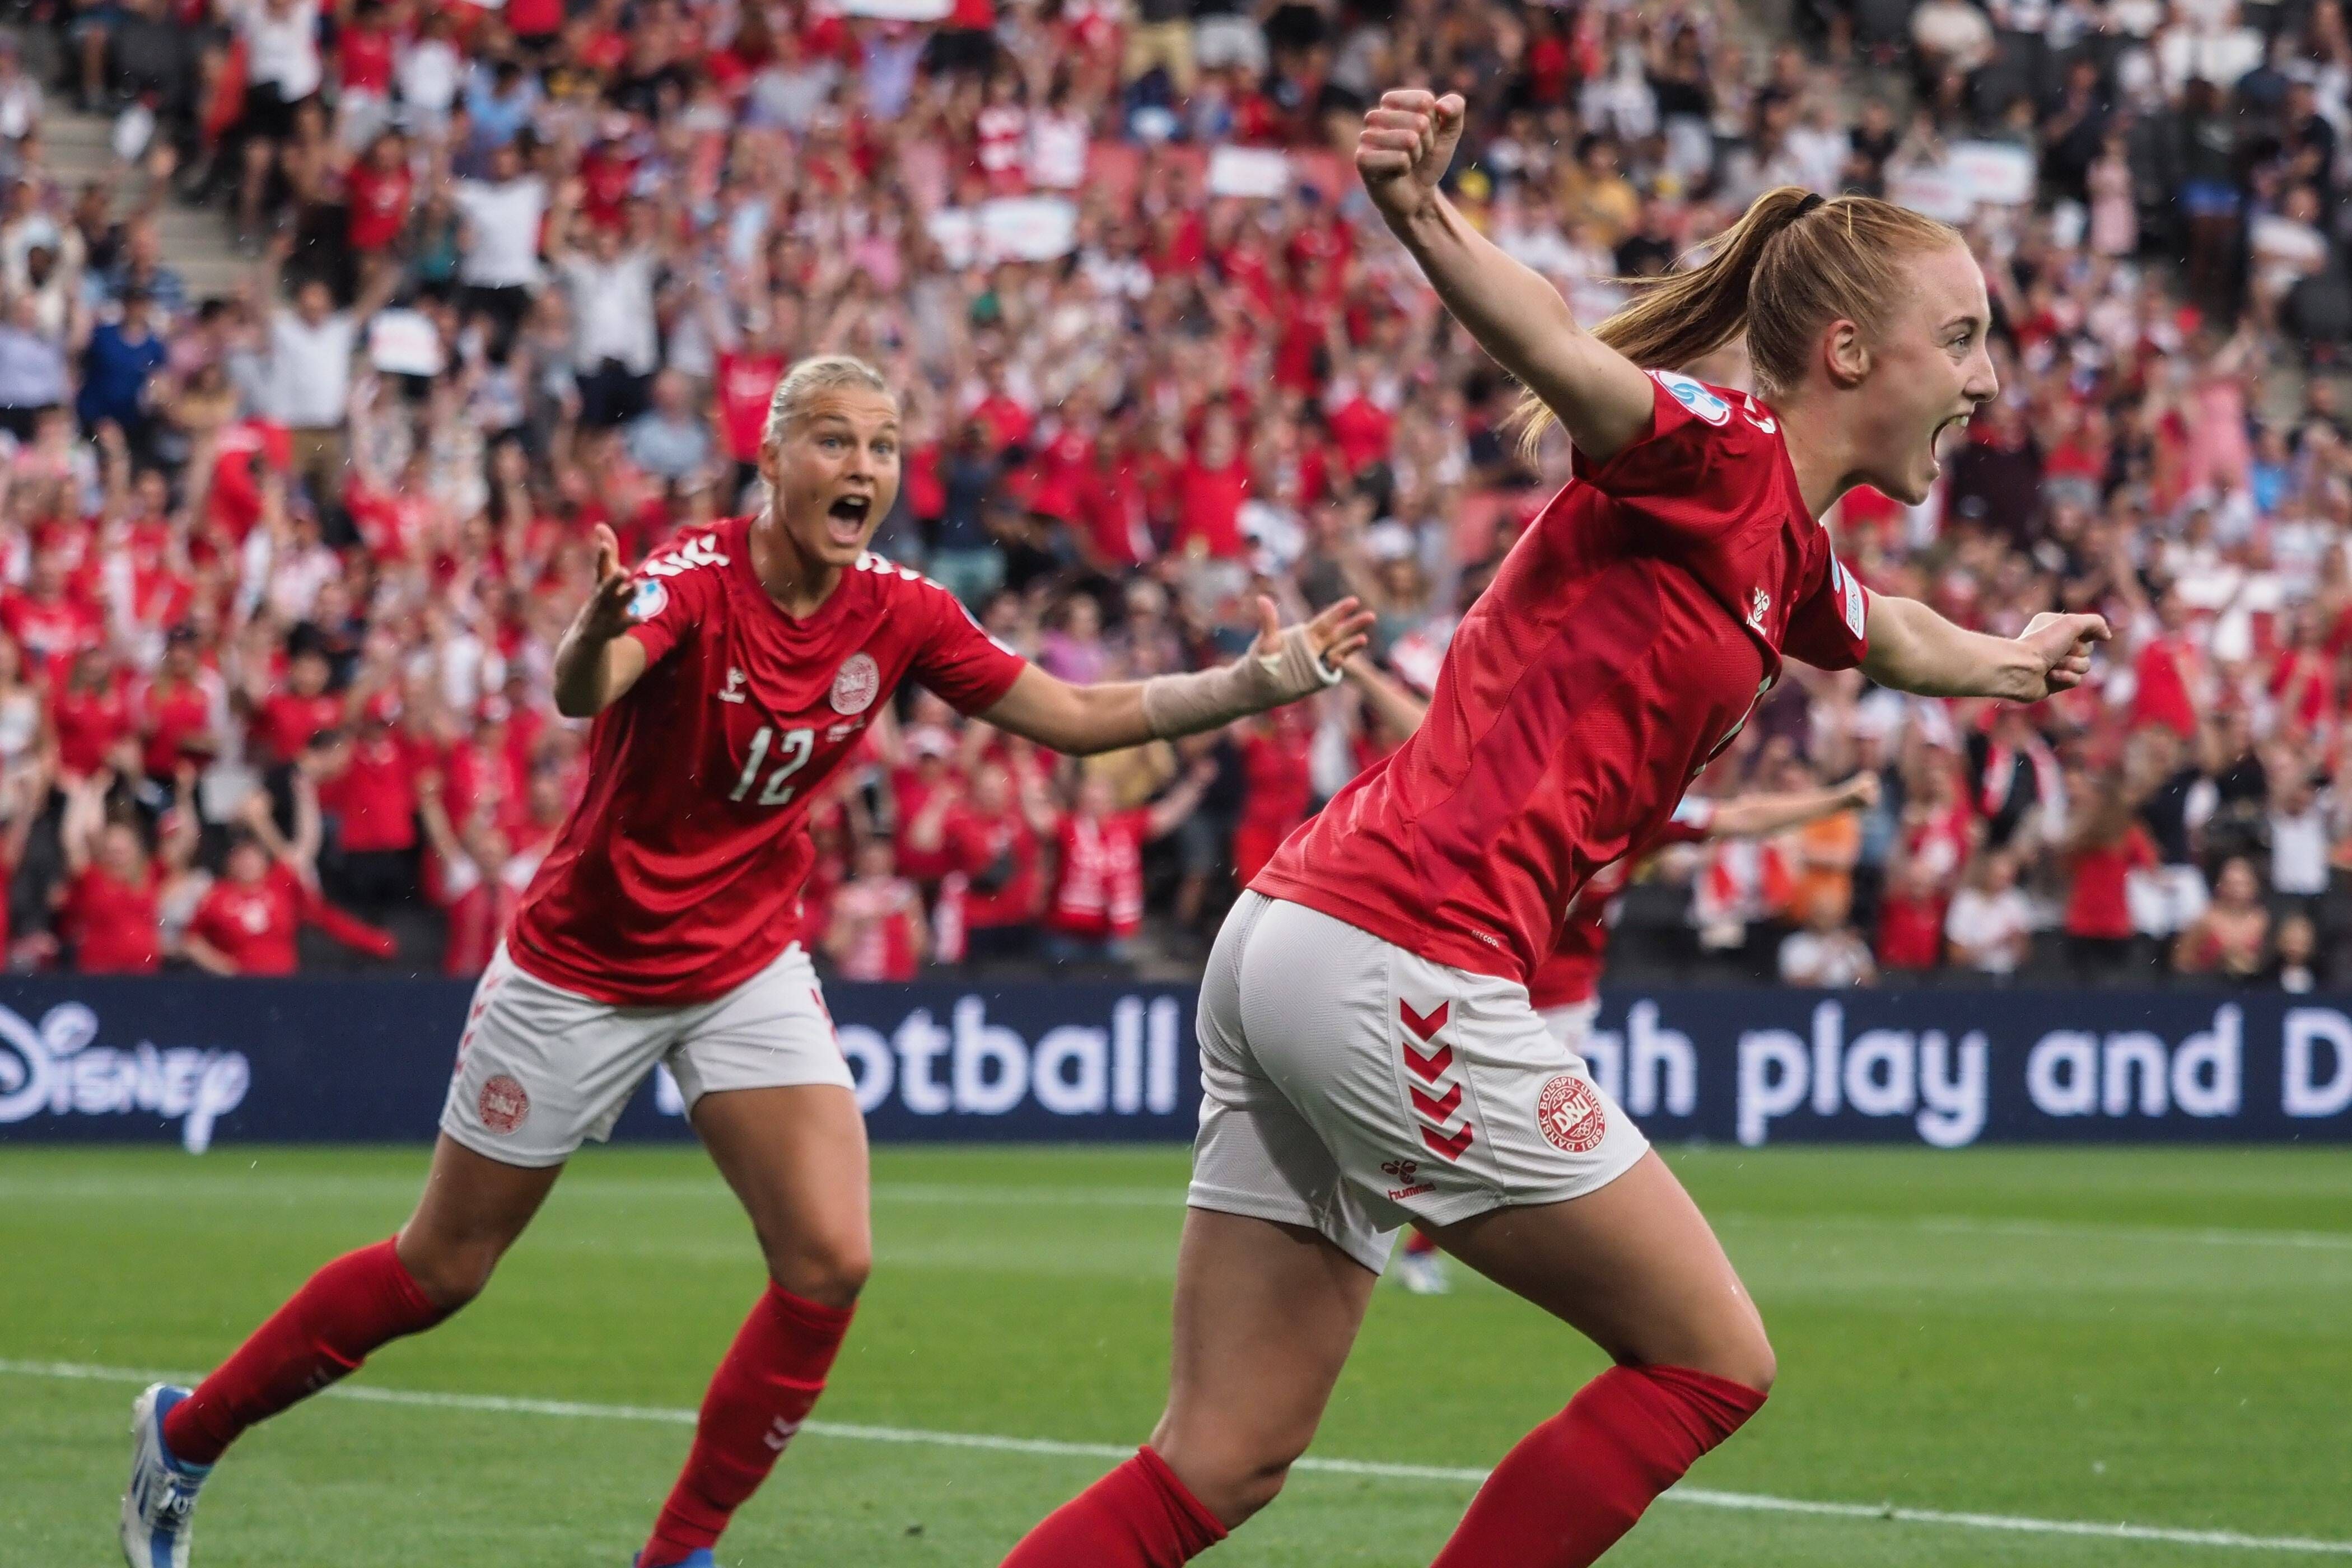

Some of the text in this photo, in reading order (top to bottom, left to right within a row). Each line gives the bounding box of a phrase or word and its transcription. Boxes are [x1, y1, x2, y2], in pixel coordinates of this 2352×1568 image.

[728, 726, 815, 805] 12
[1737, 999, 1989, 1147] play
[2026, 1002, 2241, 1117] and
[1551, 1093, 1592, 1134] DBU
[1580, 1085, 1604, 1124] UNION
[1539, 1115, 1575, 1151] DANSK
[1580, 1128, 1603, 1152] 1889
[1387, 1181, 1436, 1202] hummel
